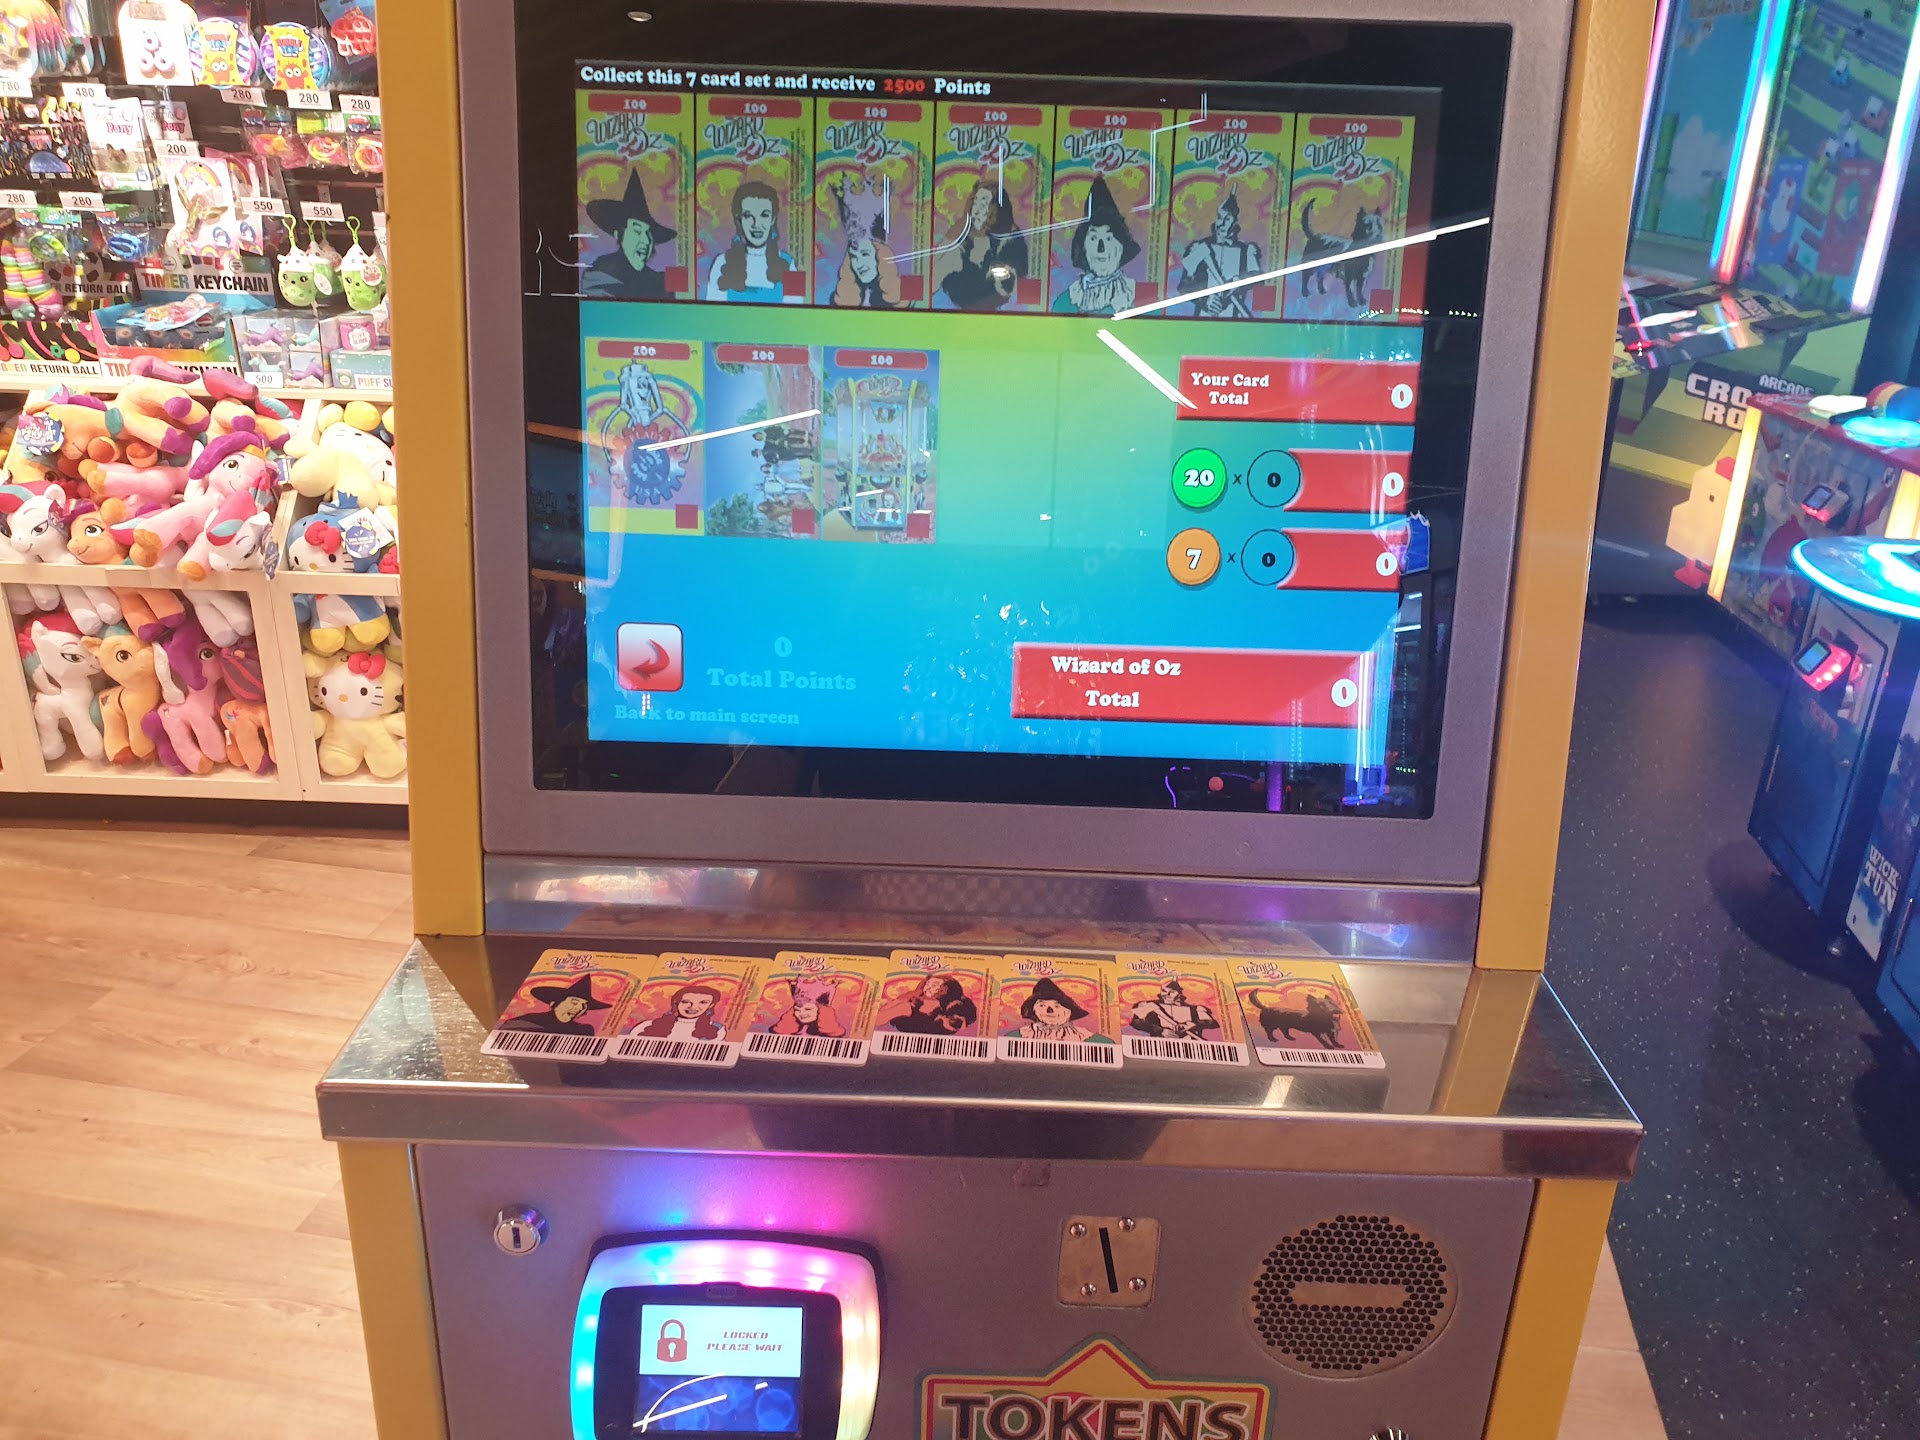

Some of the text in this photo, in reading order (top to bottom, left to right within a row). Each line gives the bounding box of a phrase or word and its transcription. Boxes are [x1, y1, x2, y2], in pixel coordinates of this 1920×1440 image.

[1, 81, 20, 91] 780
[580, 66, 991, 95] Collect this 7 card set and receive 2500 Points
[75, 87, 95, 98] 480
[231, 89, 252, 100] 280
[299, 93, 319, 103] 280
[351, 99, 371, 110] 280
[624, 99, 647, 110] 100
[744, 103, 768, 114] 100
[864, 107, 887, 118] 100
[984, 111, 1008, 122] 100
[1104, 115, 1127, 126] 100
[1224, 119, 1248, 129] 100
[106, 122, 134, 135] Pony
[162, 120, 185, 133] Pony
[1344, 123, 1368, 134] 100
[167, 144, 187, 154] 200
[6, 193, 26, 203] 280
[72, 196, 92, 206] 280
[254, 201, 273, 211] 550
[313, 206, 333, 216] 550
[141, 273, 270, 292] TIMER KEYCHAIN
[65, 284, 103, 294] RETURN
[107, 284, 129, 294] BALL
[633, 345, 656, 357] 100
[752, 350, 775, 362] 100
[871, 354, 894, 366] 100
[30, 364, 70, 375] RETURN
[73, 366, 99, 375] BALL
[256, 375, 273, 384] 500
[358, 378, 381, 388] PUFF
[1191, 372, 1270, 388] Your Card
[1208, 391, 1249, 405] Total
[1391, 383, 1414, 409] 0
[1183, 469, 1215, 489] 20
[1267, 472, 1281, 488] 0
[1382, 471, 1405, 497] 0
[1186, 548, 1202, 570] 7
[1261, 552, 1276, 568] 0
[1375, 551, 1398, 577] 0
[774, 636, 793, 658] 0
[1051, 656, 1182, 676] Wizard of Oz
[706, 668, 857, 690] Total Points
[1331, 678, 1358, 708] 0
[1085, 690, 1140, 708] Total
[615, 704, 799, 725] Back to main screen
[723, 1331, 769, 1339] LOCKED
[707, 1343, 784, 1352] PLEASE WAIT
[939, 1391, 1251, 1440] TOKENS
